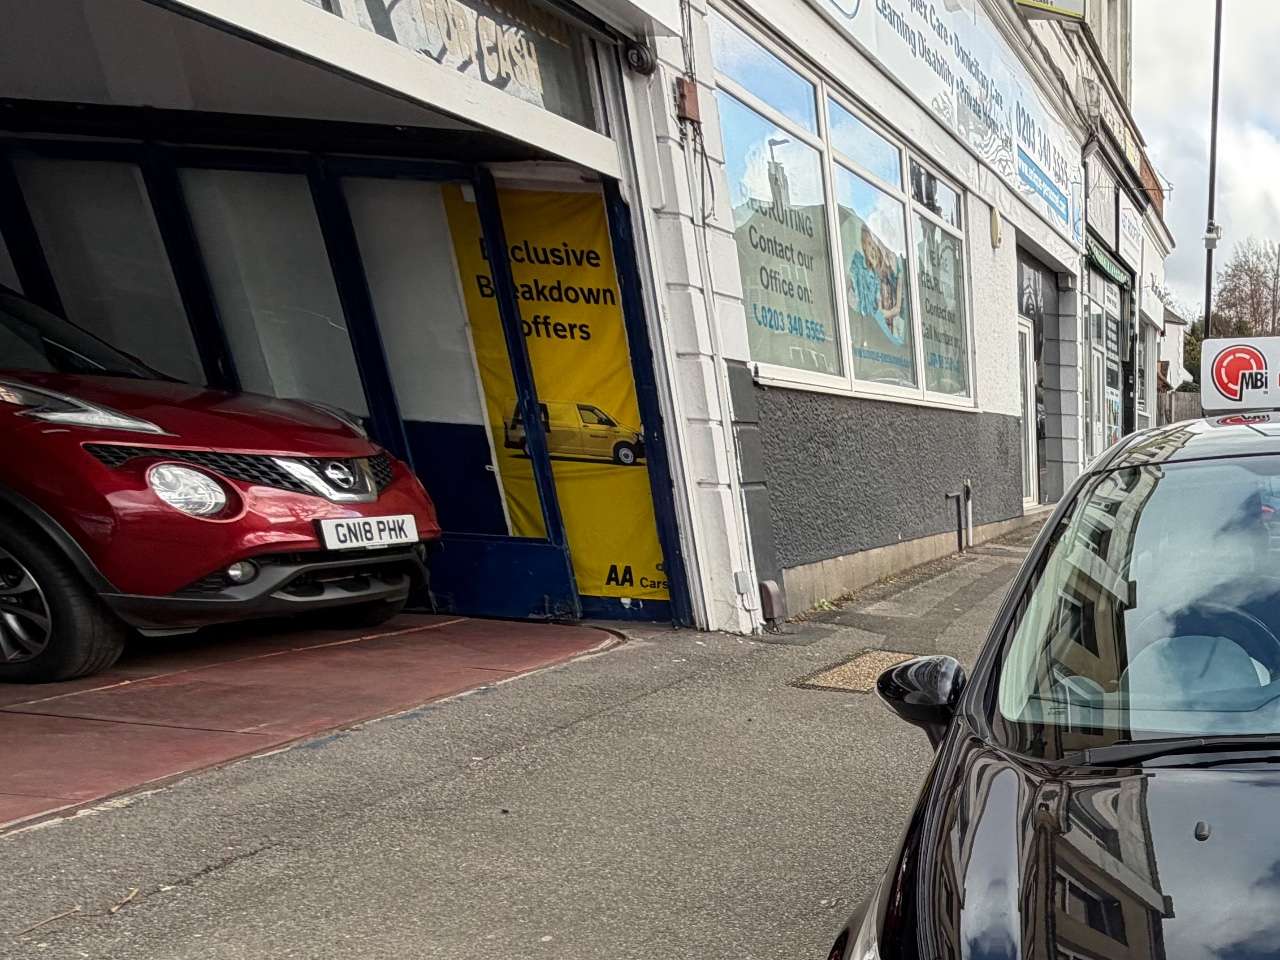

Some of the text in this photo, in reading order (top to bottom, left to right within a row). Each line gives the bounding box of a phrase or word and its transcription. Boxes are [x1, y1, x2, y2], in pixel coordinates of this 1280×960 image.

[929, 4, 948, 46] Care
[875, 0, 917, 58] Learning
[917, 30, 955, 96] Disability
[1015, 100, 1035, 154] 0203
[749, 224, 814, 272] Contact our
[760, 266, 794, 298] Office
[521, 315, 591, 340] offers
[761, 306, 785, 332] 0203
[787, 313, 804, 337] 340
[334, 519, 408, 544] GN18 PHK
[605, 564, 634, 587] AA
[640, 577, 668, 590] Cars
